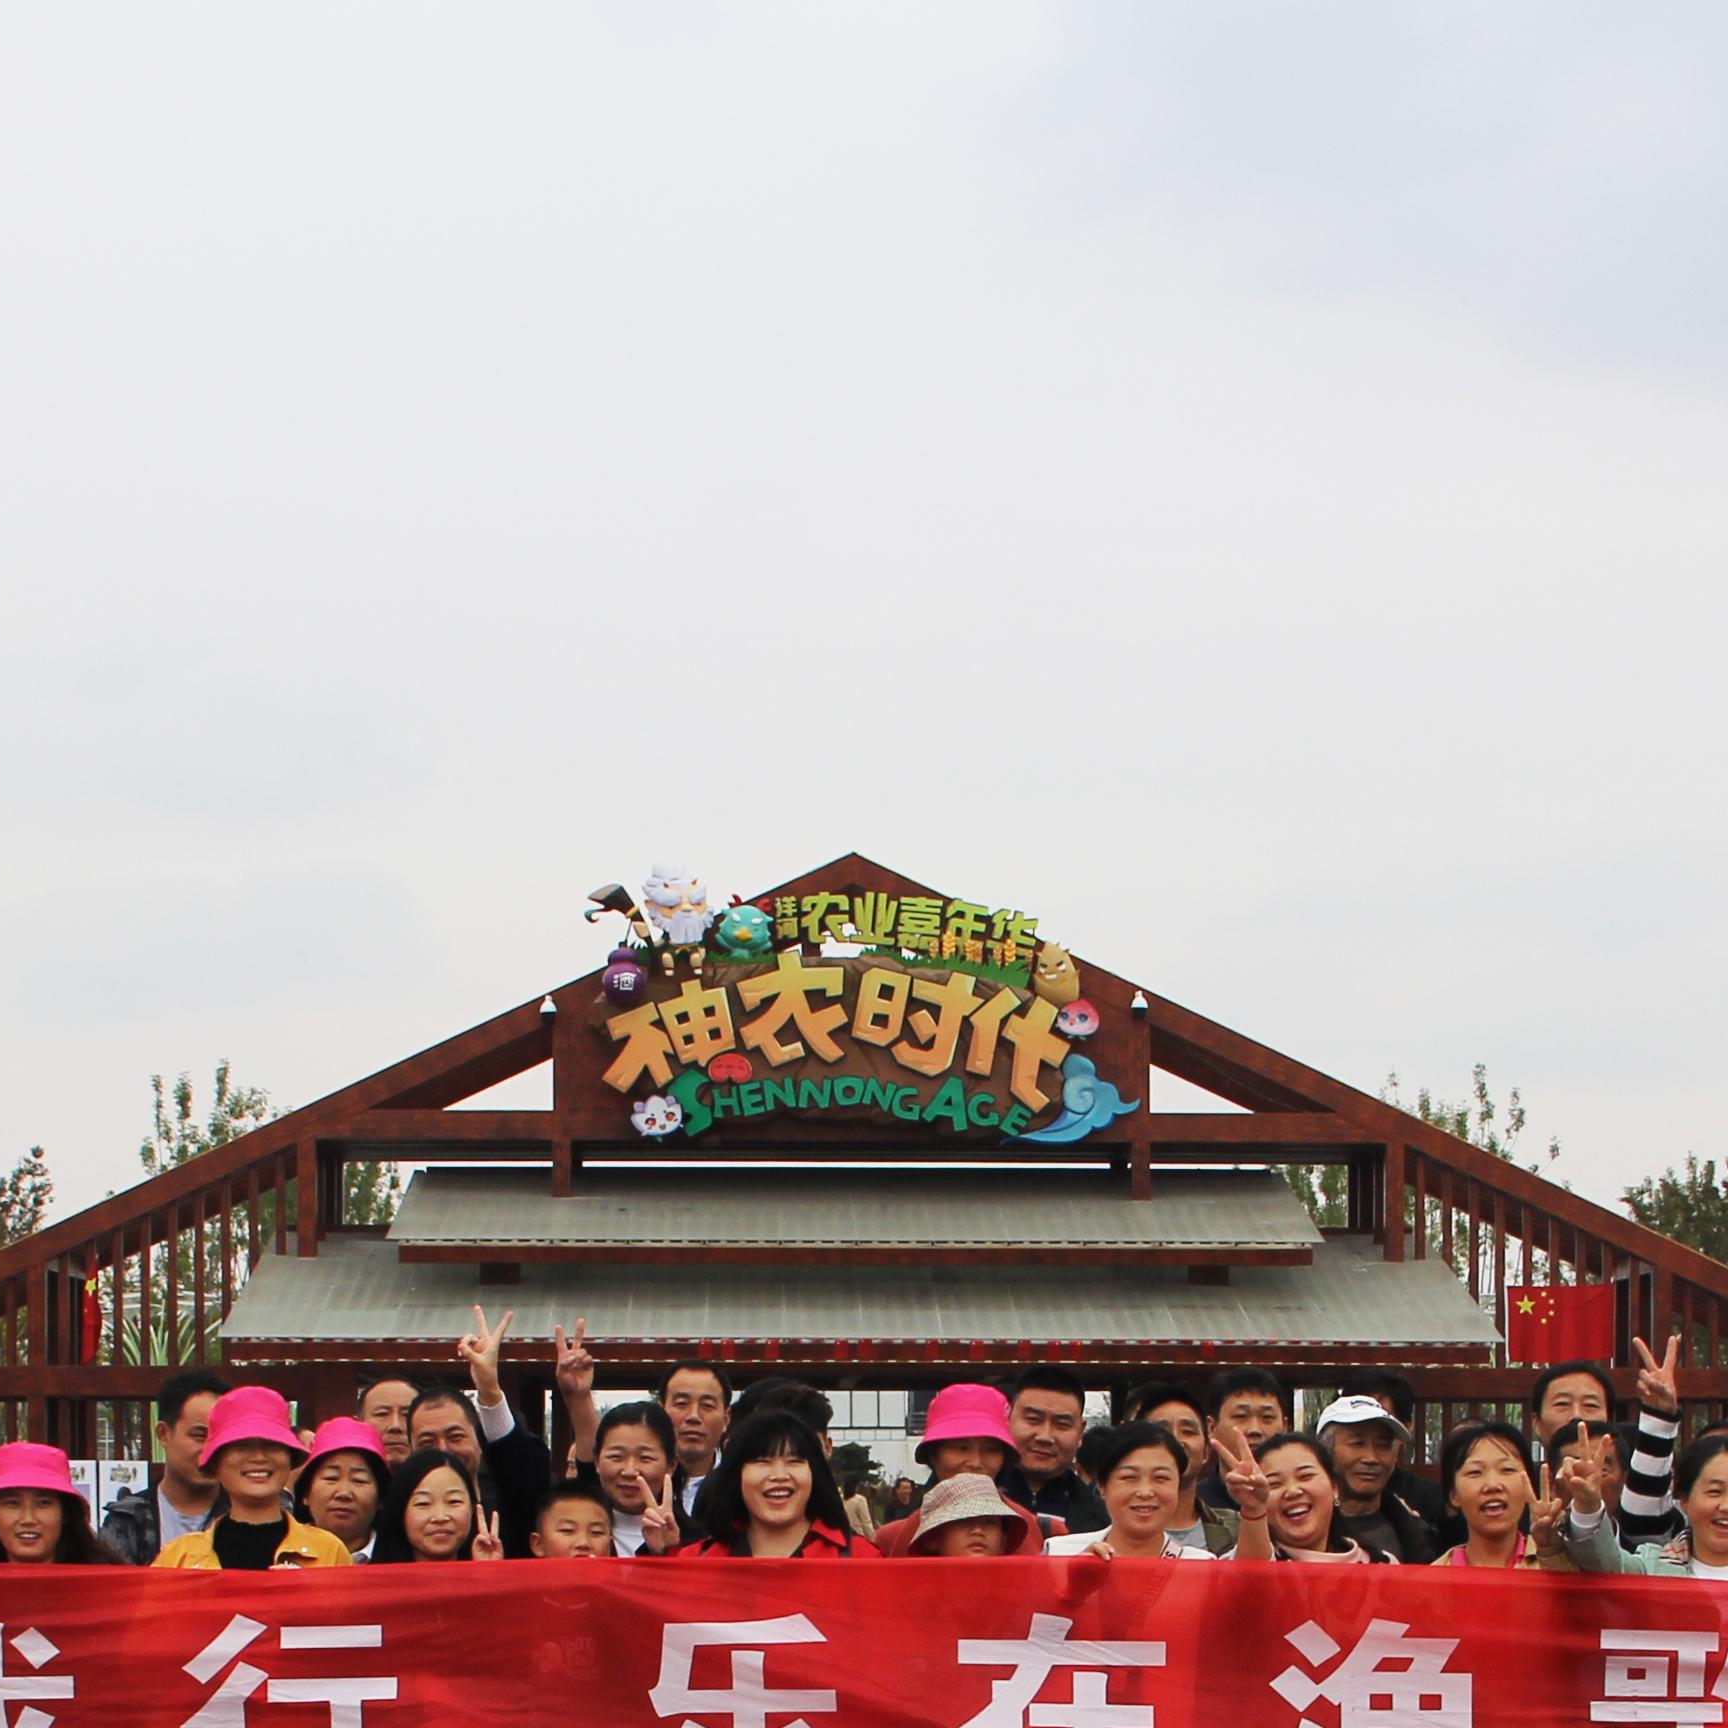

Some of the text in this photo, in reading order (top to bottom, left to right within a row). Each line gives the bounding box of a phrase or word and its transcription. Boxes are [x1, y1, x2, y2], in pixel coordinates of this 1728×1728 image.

[801, 891, 1038, 959] 农业嘉年华
[602, 951, 1070, 1113] 神农时代
[669, 1067, 1037, 1137] SHENNONG AGE
